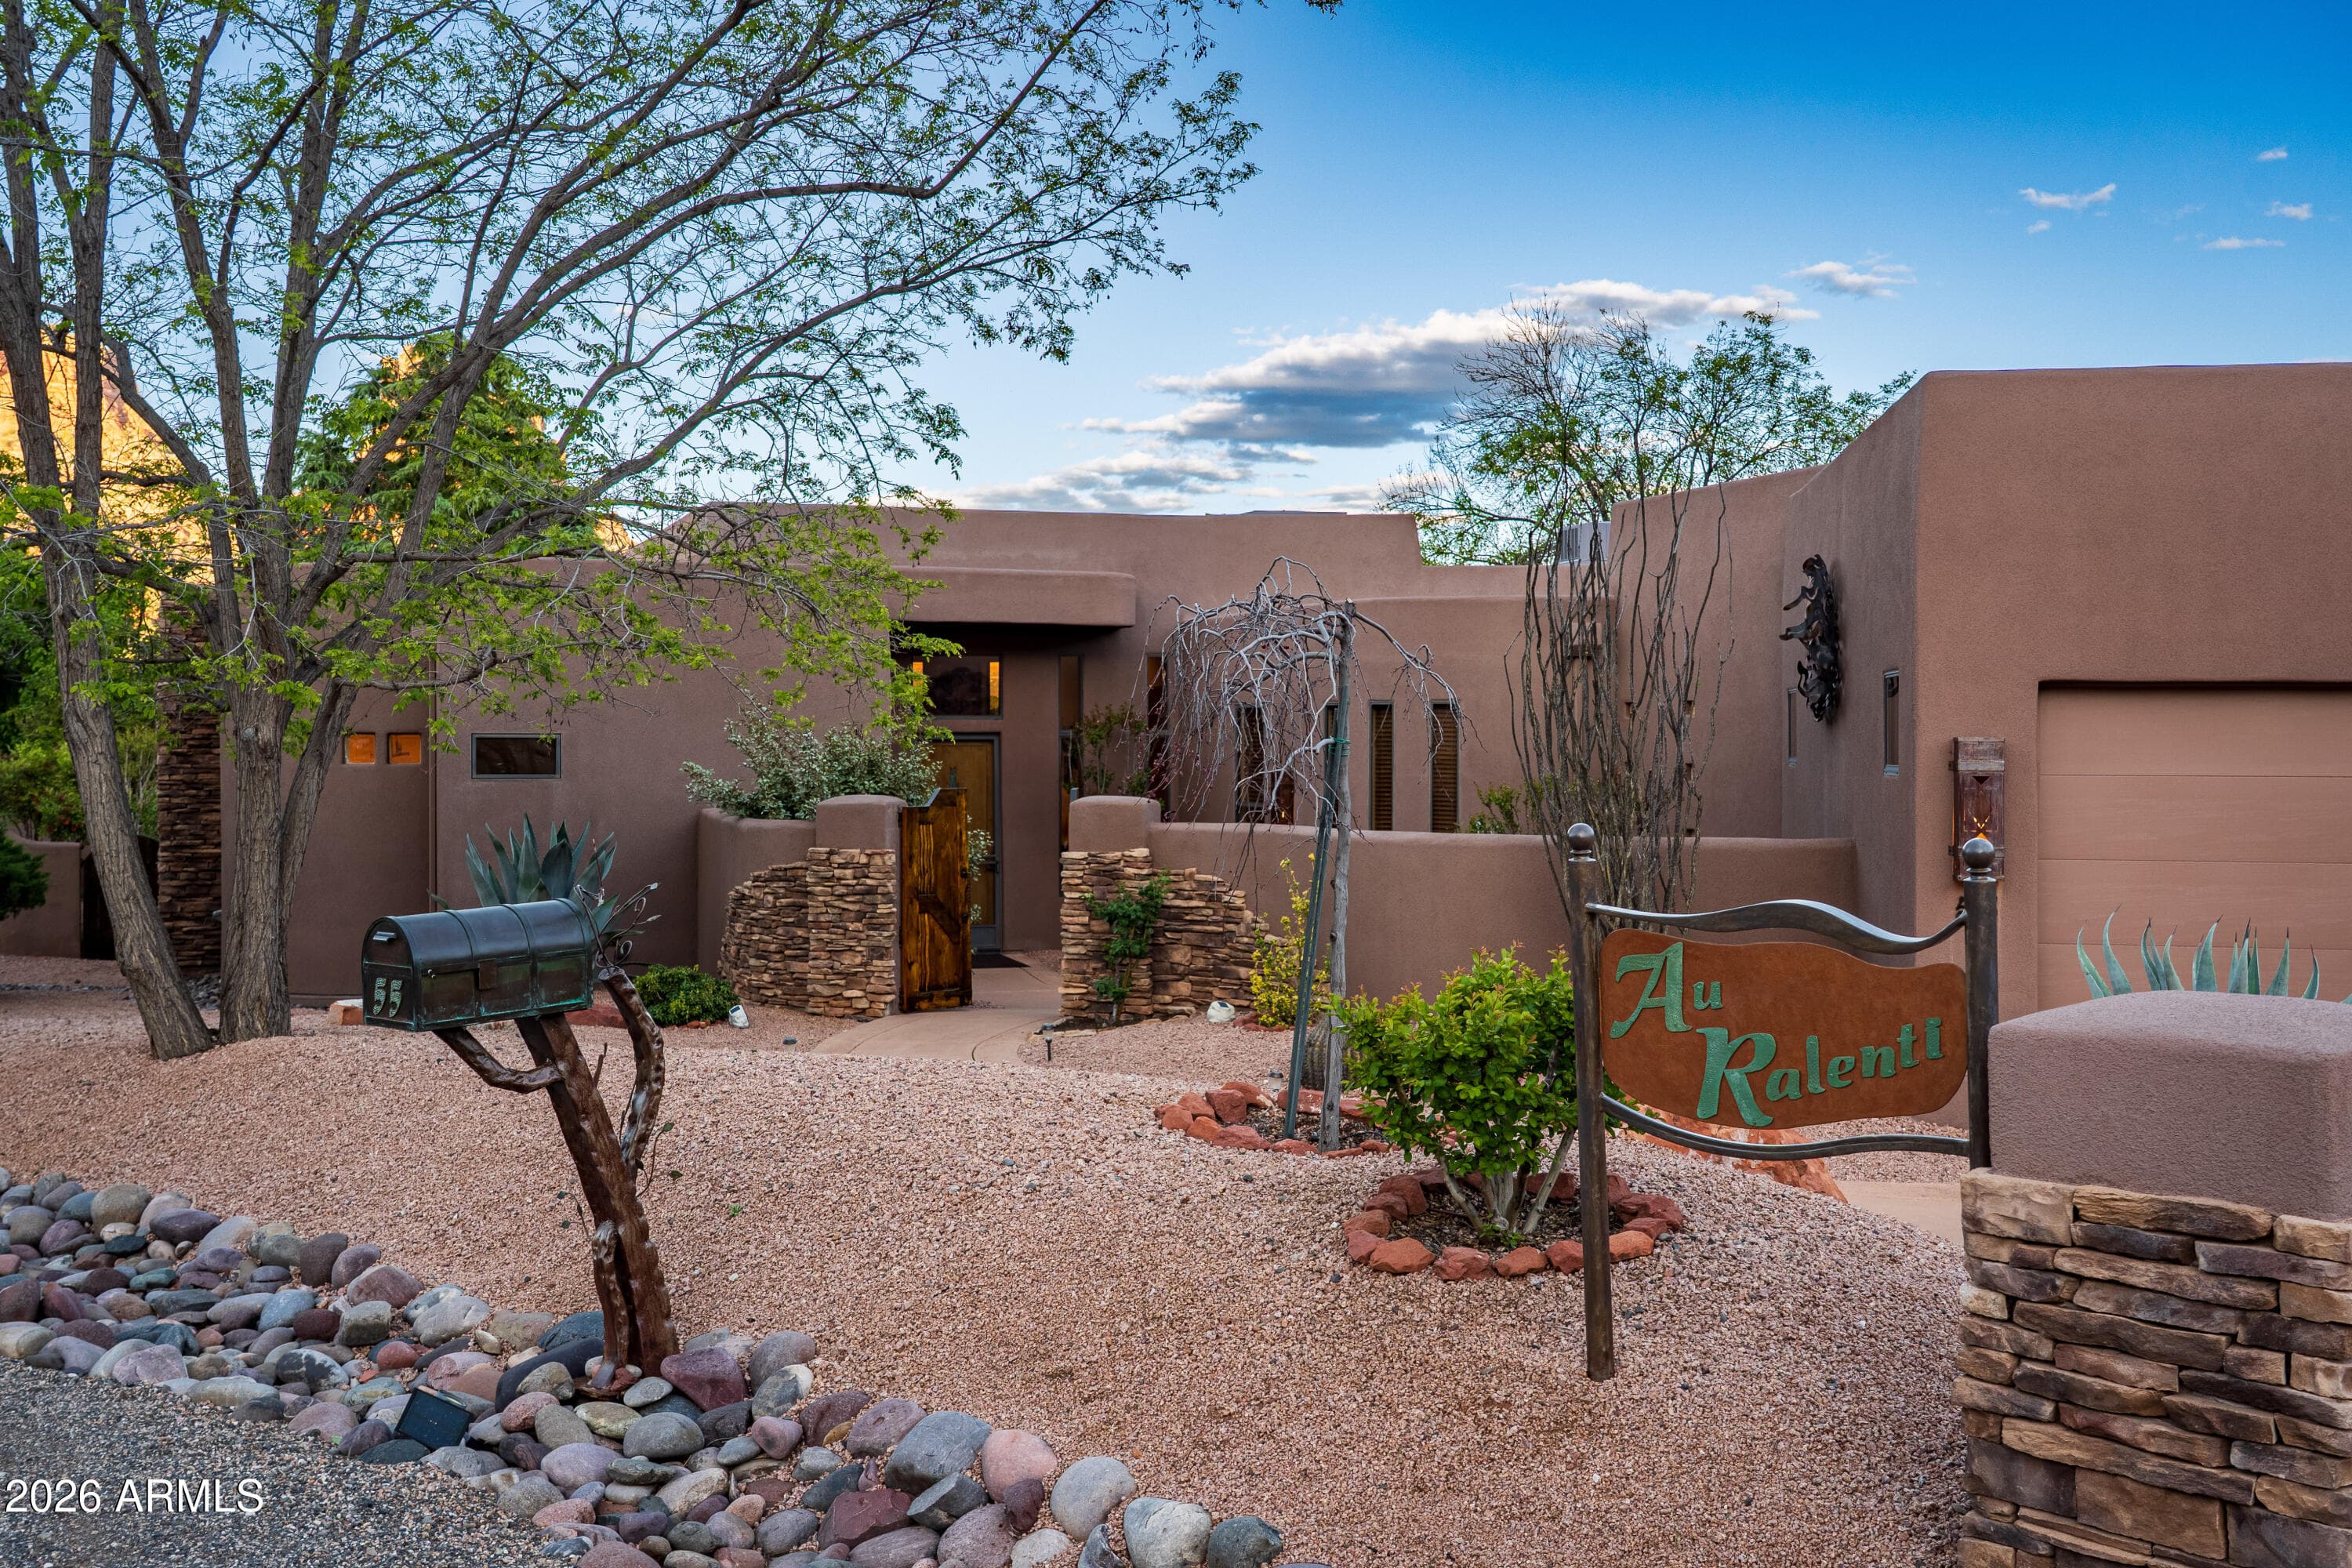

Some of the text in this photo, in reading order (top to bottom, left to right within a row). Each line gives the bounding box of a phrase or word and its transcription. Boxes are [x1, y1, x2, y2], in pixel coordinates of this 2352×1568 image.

[372, 977, 402, 1018] 55
[1610, 942, 1723, 1039] Au
[1695, 1017, 1945, 1127] Ralenti
